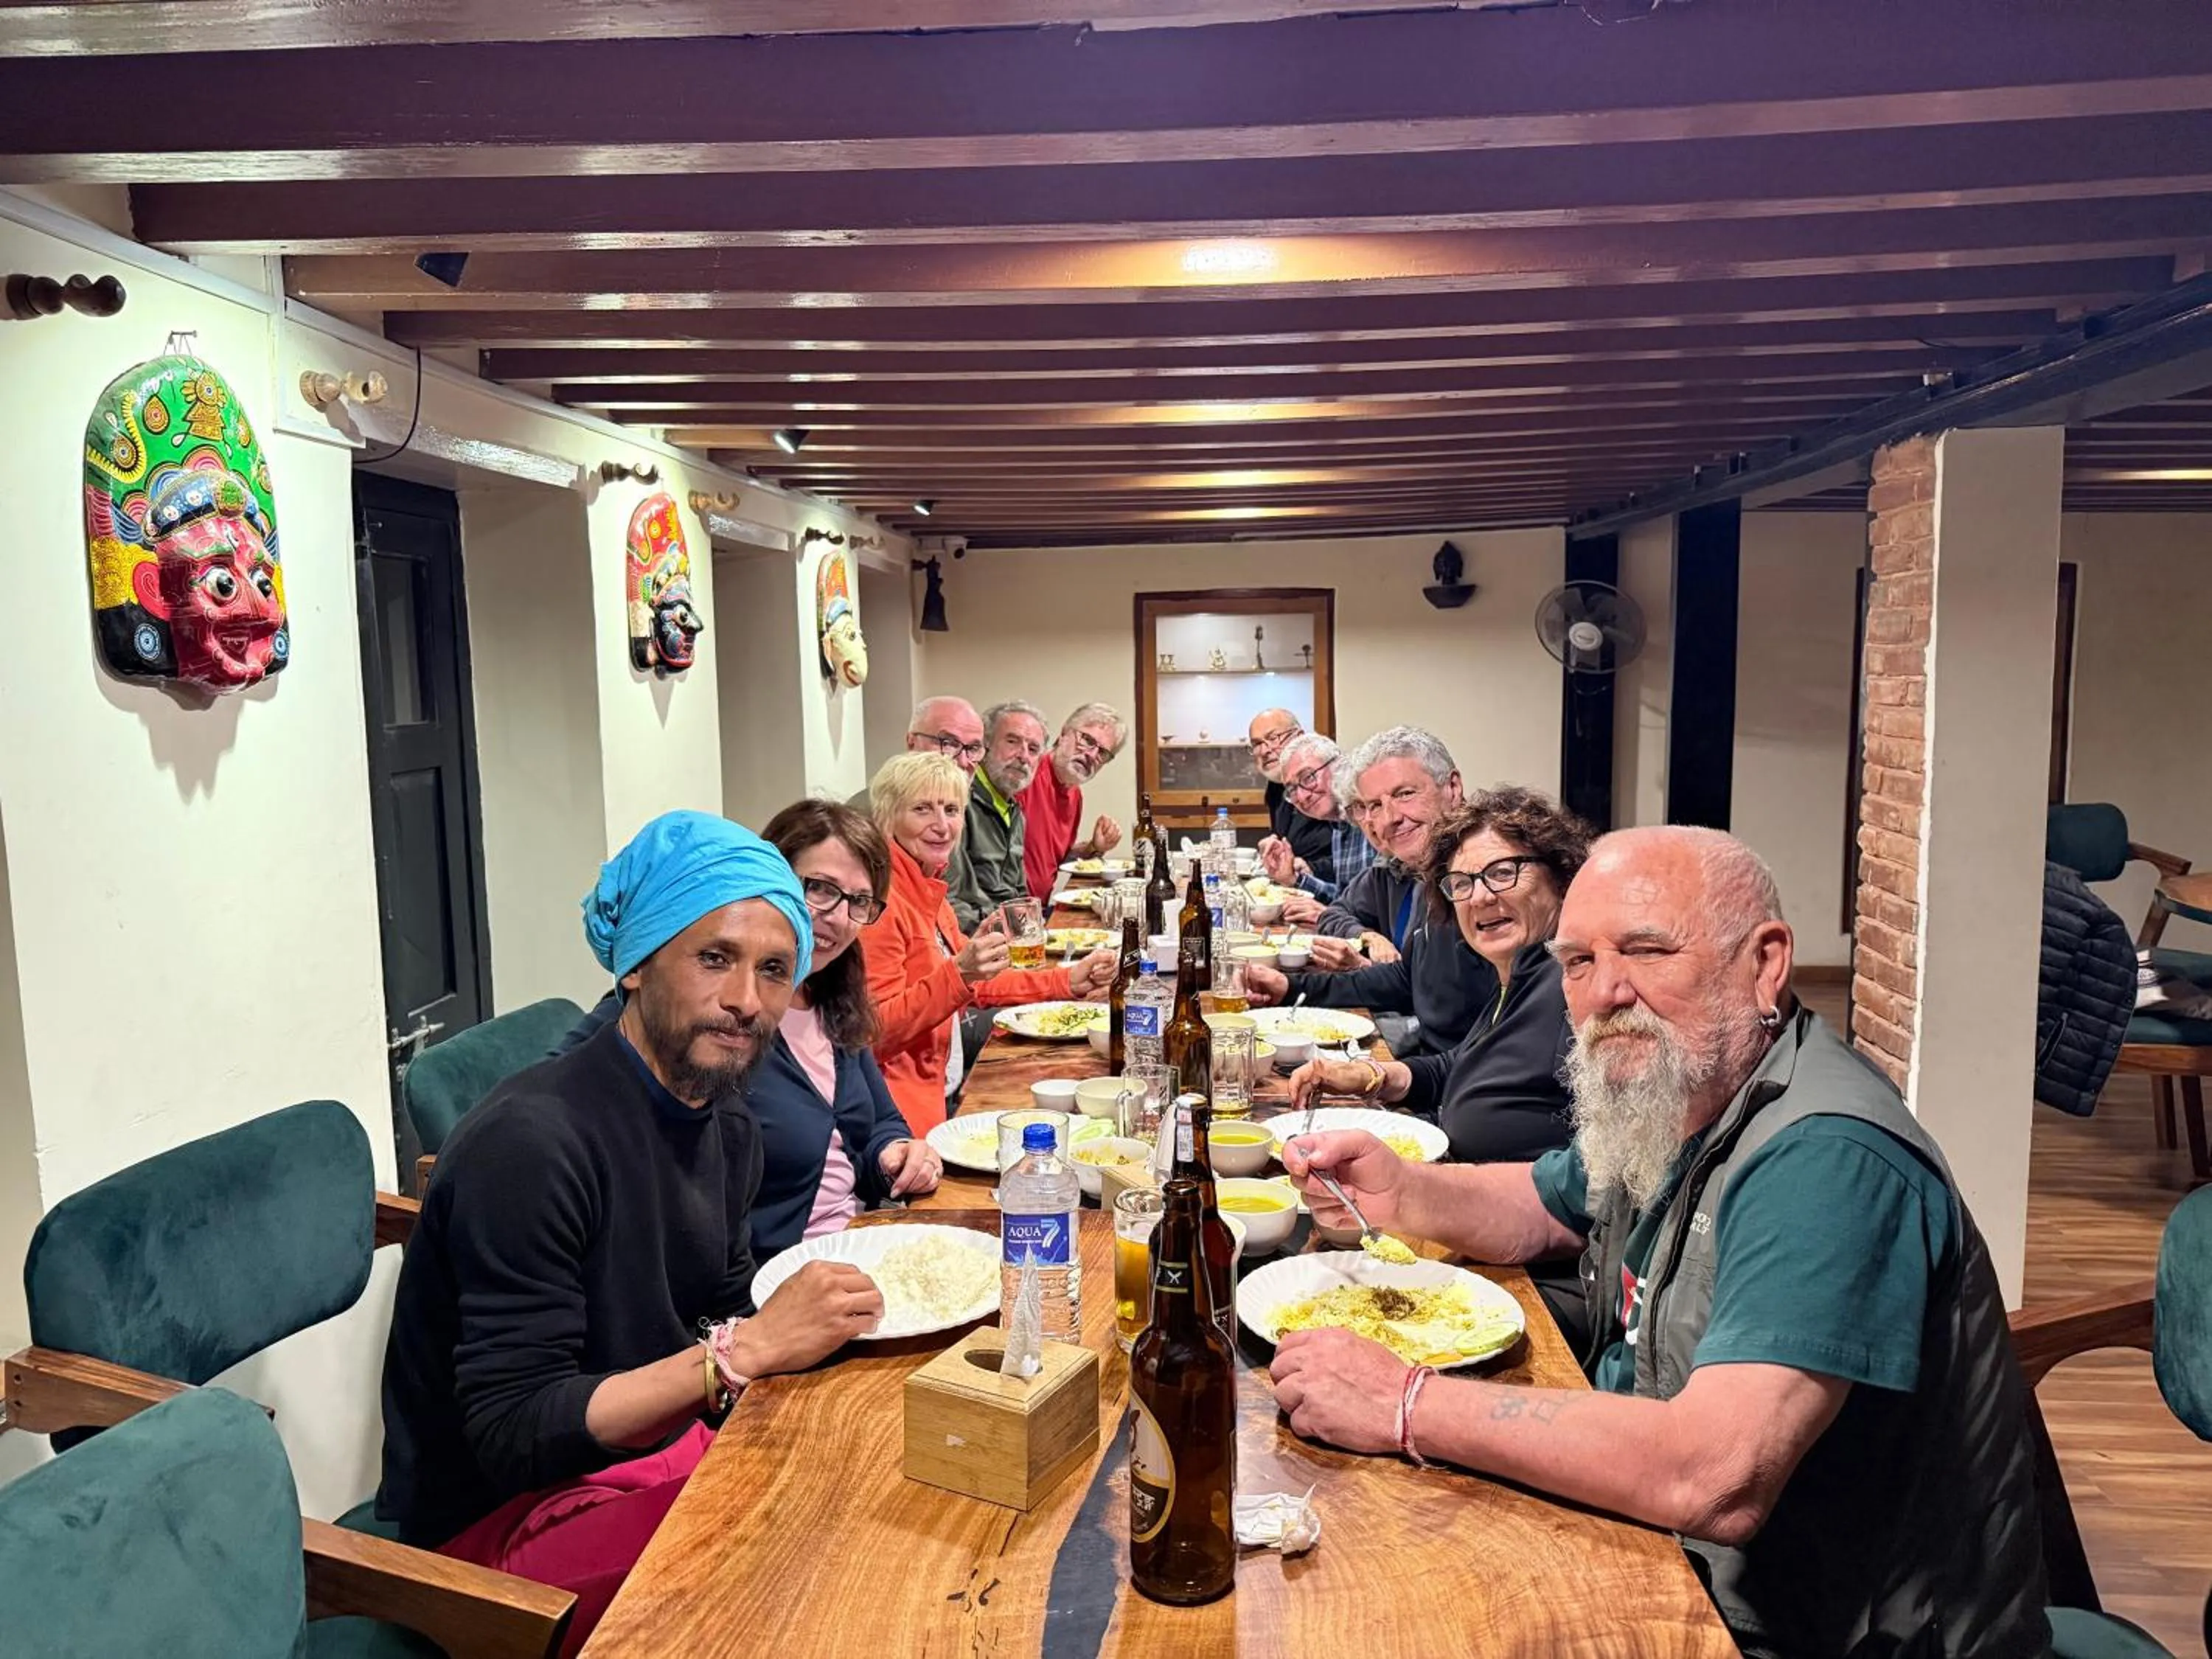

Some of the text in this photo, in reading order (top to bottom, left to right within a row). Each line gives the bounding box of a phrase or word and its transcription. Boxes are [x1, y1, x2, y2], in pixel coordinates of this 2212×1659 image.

[1142, 1009, 1154, 1026] 7
[1008, 1218, 1060, 1248] AQUA 7
